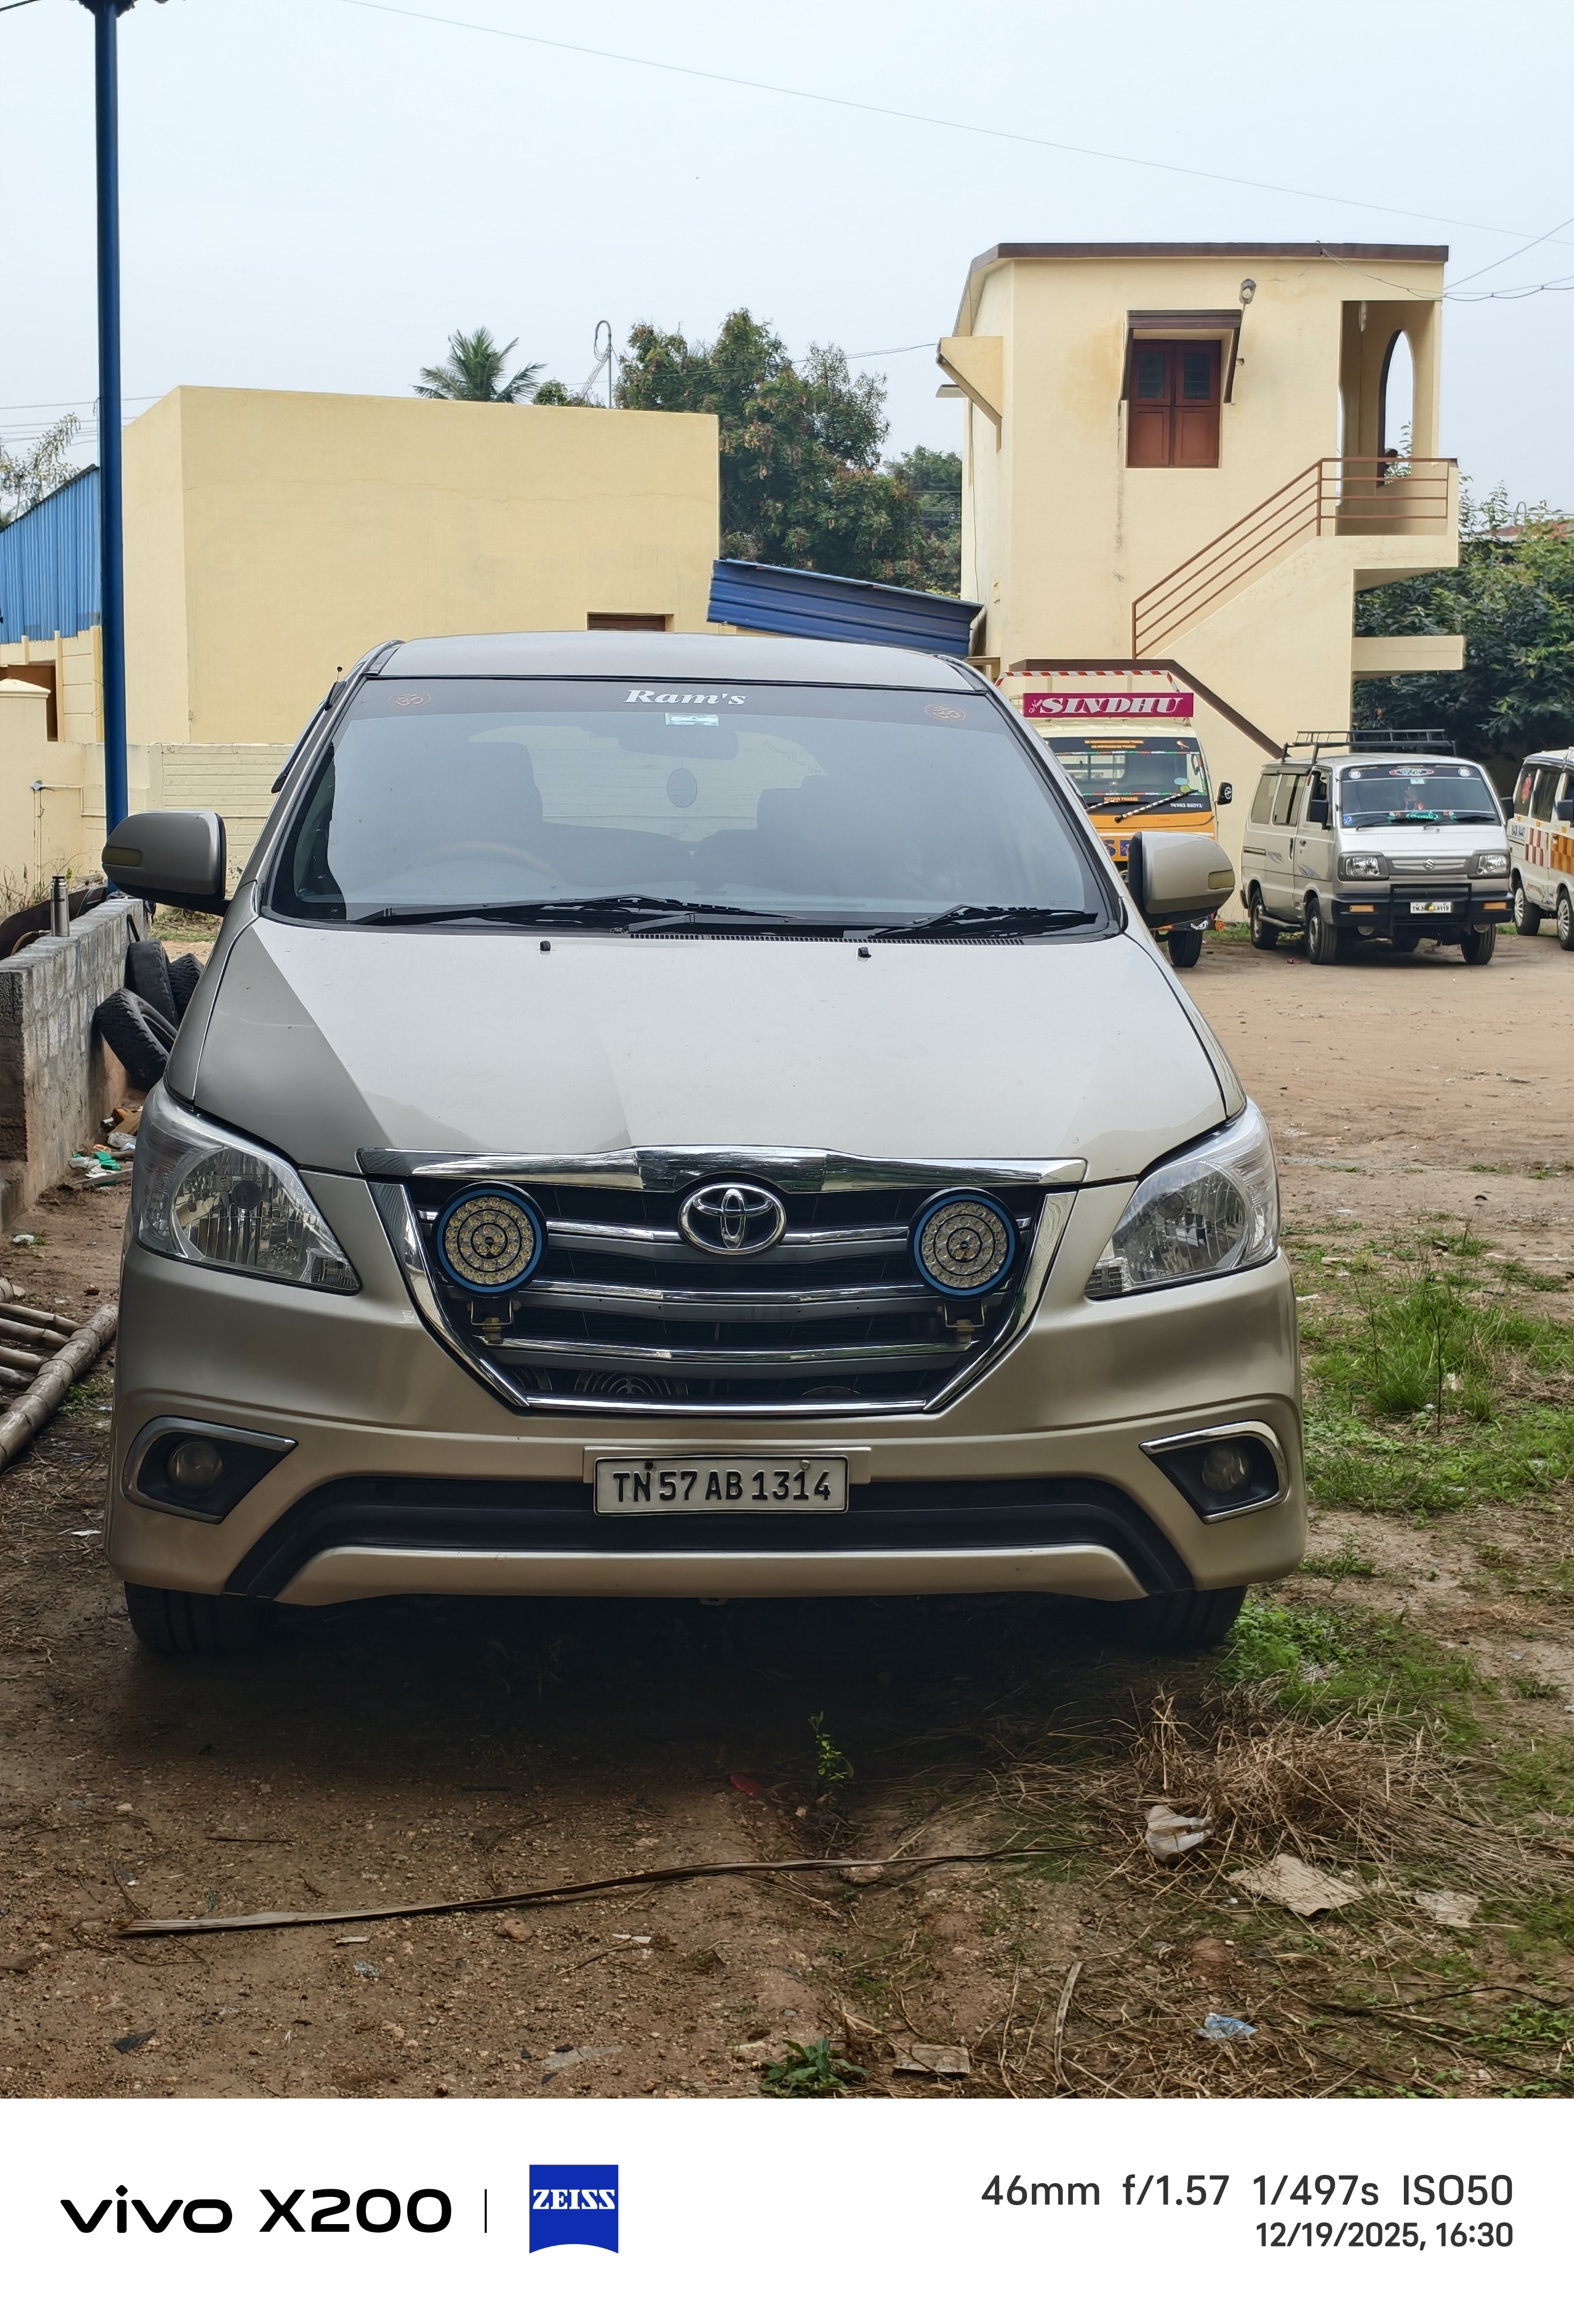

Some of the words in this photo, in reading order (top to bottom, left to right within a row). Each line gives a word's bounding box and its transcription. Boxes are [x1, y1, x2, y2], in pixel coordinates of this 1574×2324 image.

[622, 690, 747, 705] Ram's
[1040, 697, 1184, 714] SINDHU
[613, 1471, 651, 1502] TN
[659, 1471, 698, 1501] 57
[705, 1470, 743, 1501] AB
[751, 1469, 831, 1501] 1314
